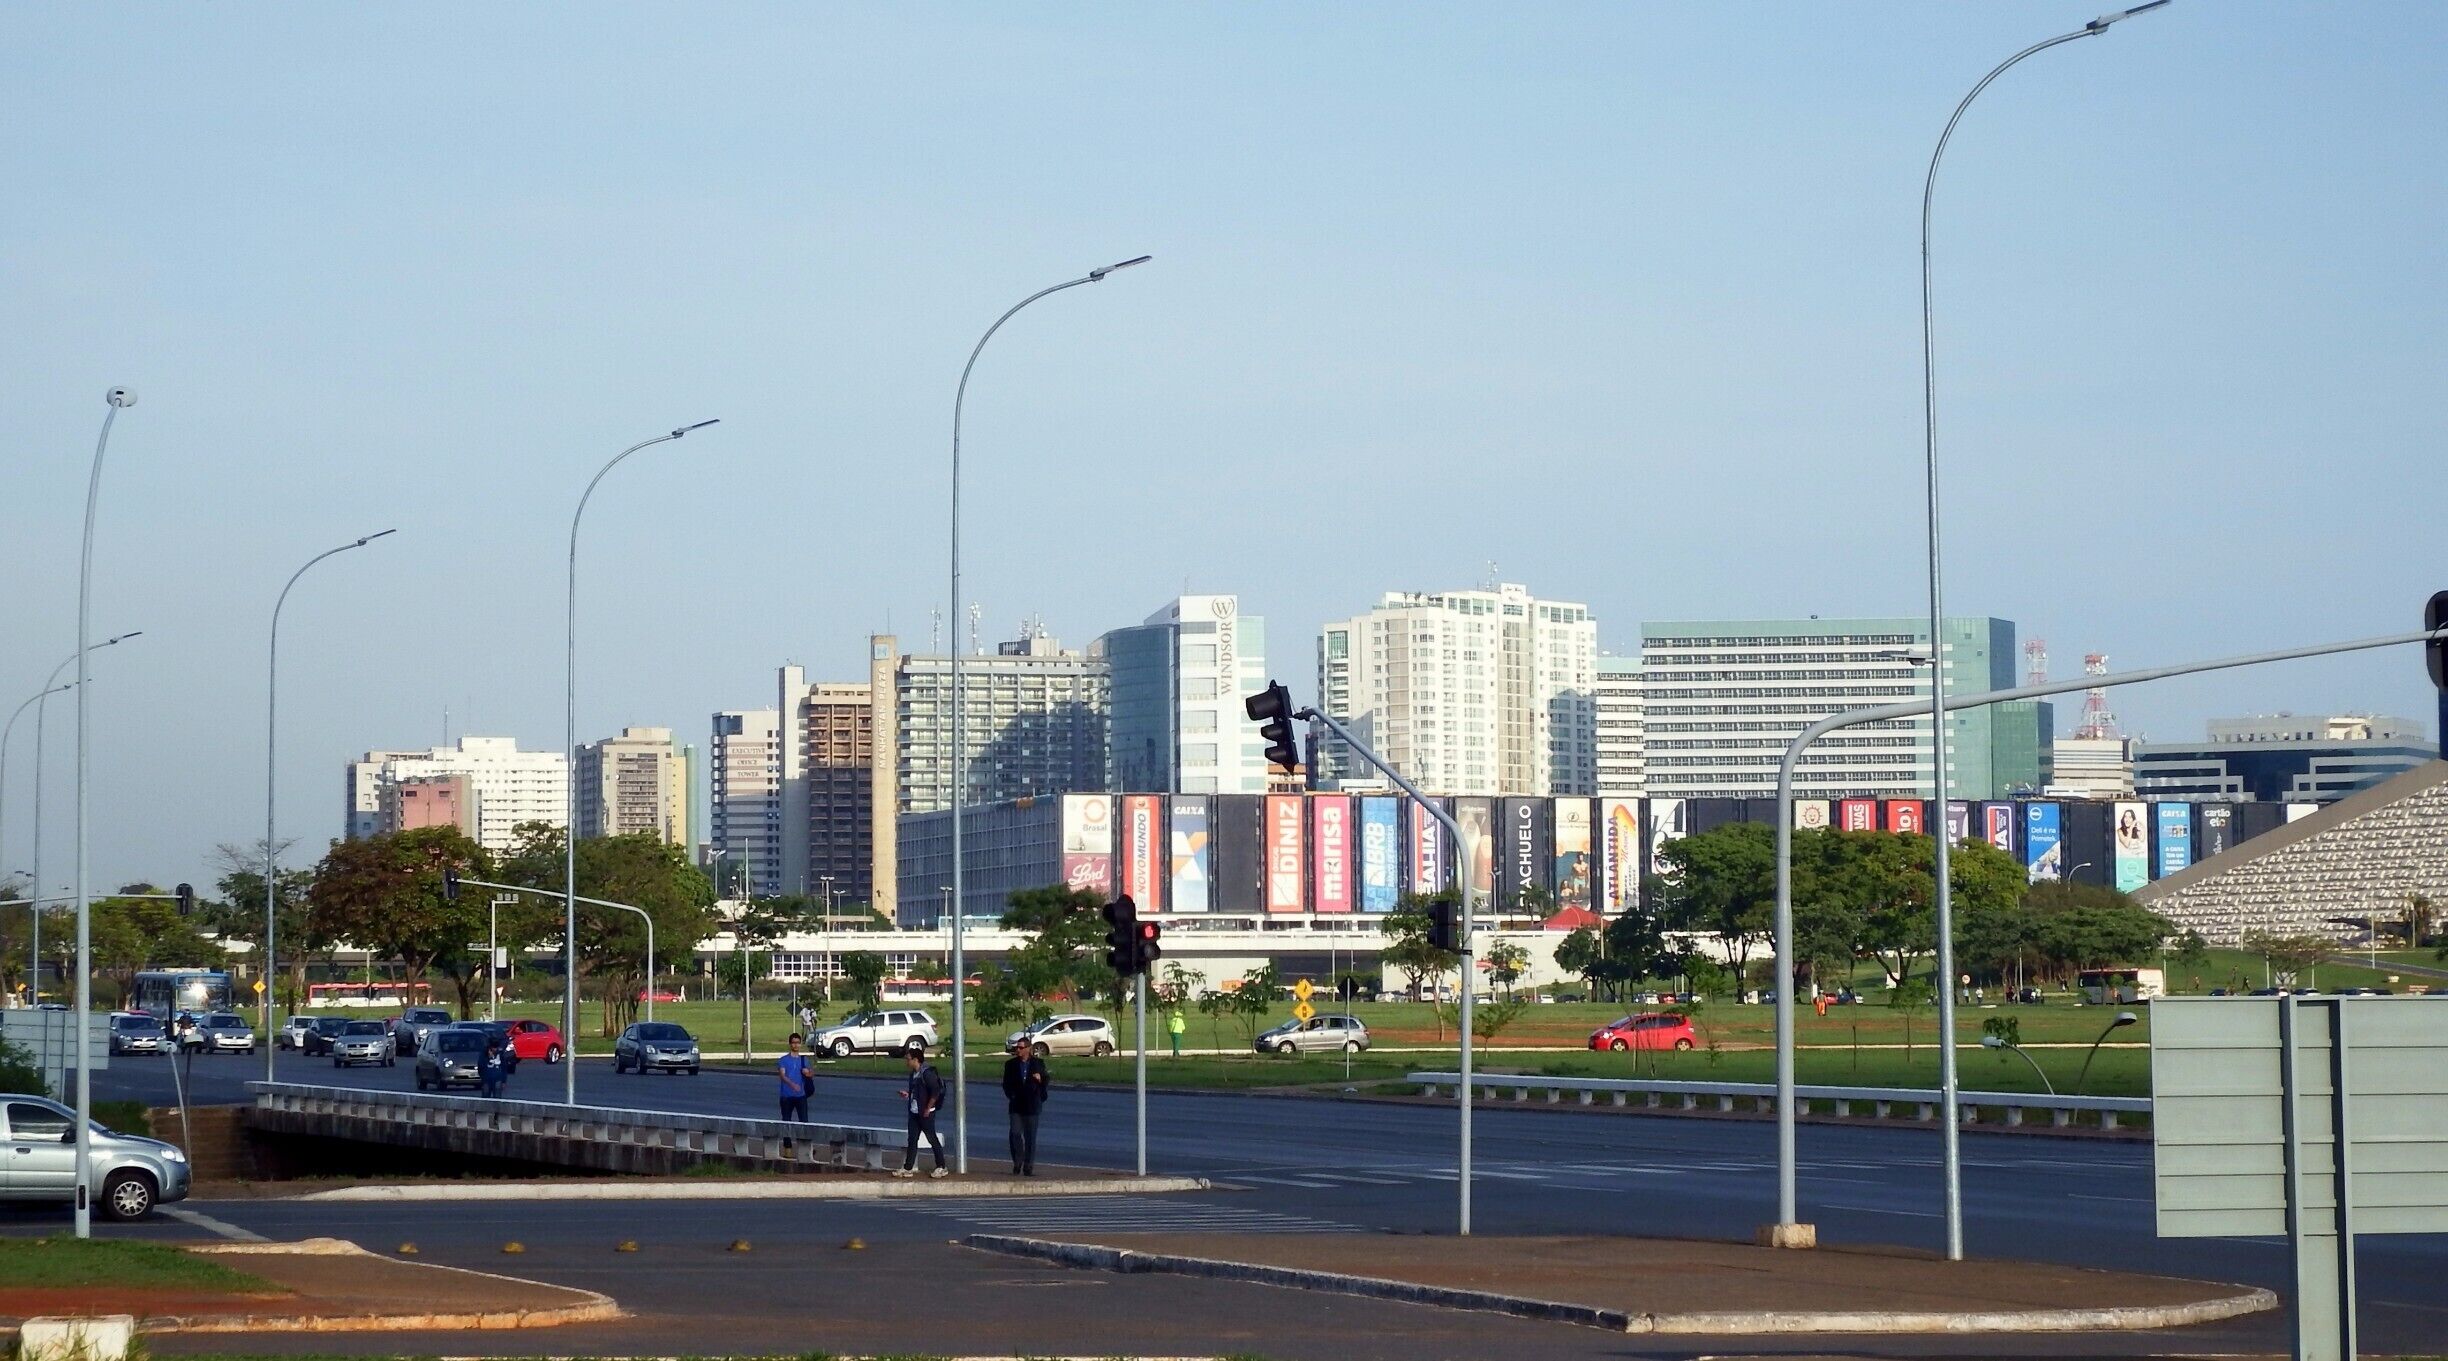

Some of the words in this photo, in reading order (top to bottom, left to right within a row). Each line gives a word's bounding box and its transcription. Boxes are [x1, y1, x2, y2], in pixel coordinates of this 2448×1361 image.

[1220, 621, 1233, 695] WINDSOR
[1174, 806, 1205, 816] CAIXA
[1279, 801, 1299, 873] DINIZ
[2161, 810, 2187, 818] CAIXA
[1137, 813, 1148, 895] NOVOMUNDO
[1322, 806, 1343, 900] marisa
[1366, 822, 1387, 864] BRB
[1068, 862, 1107, 886] Lord
